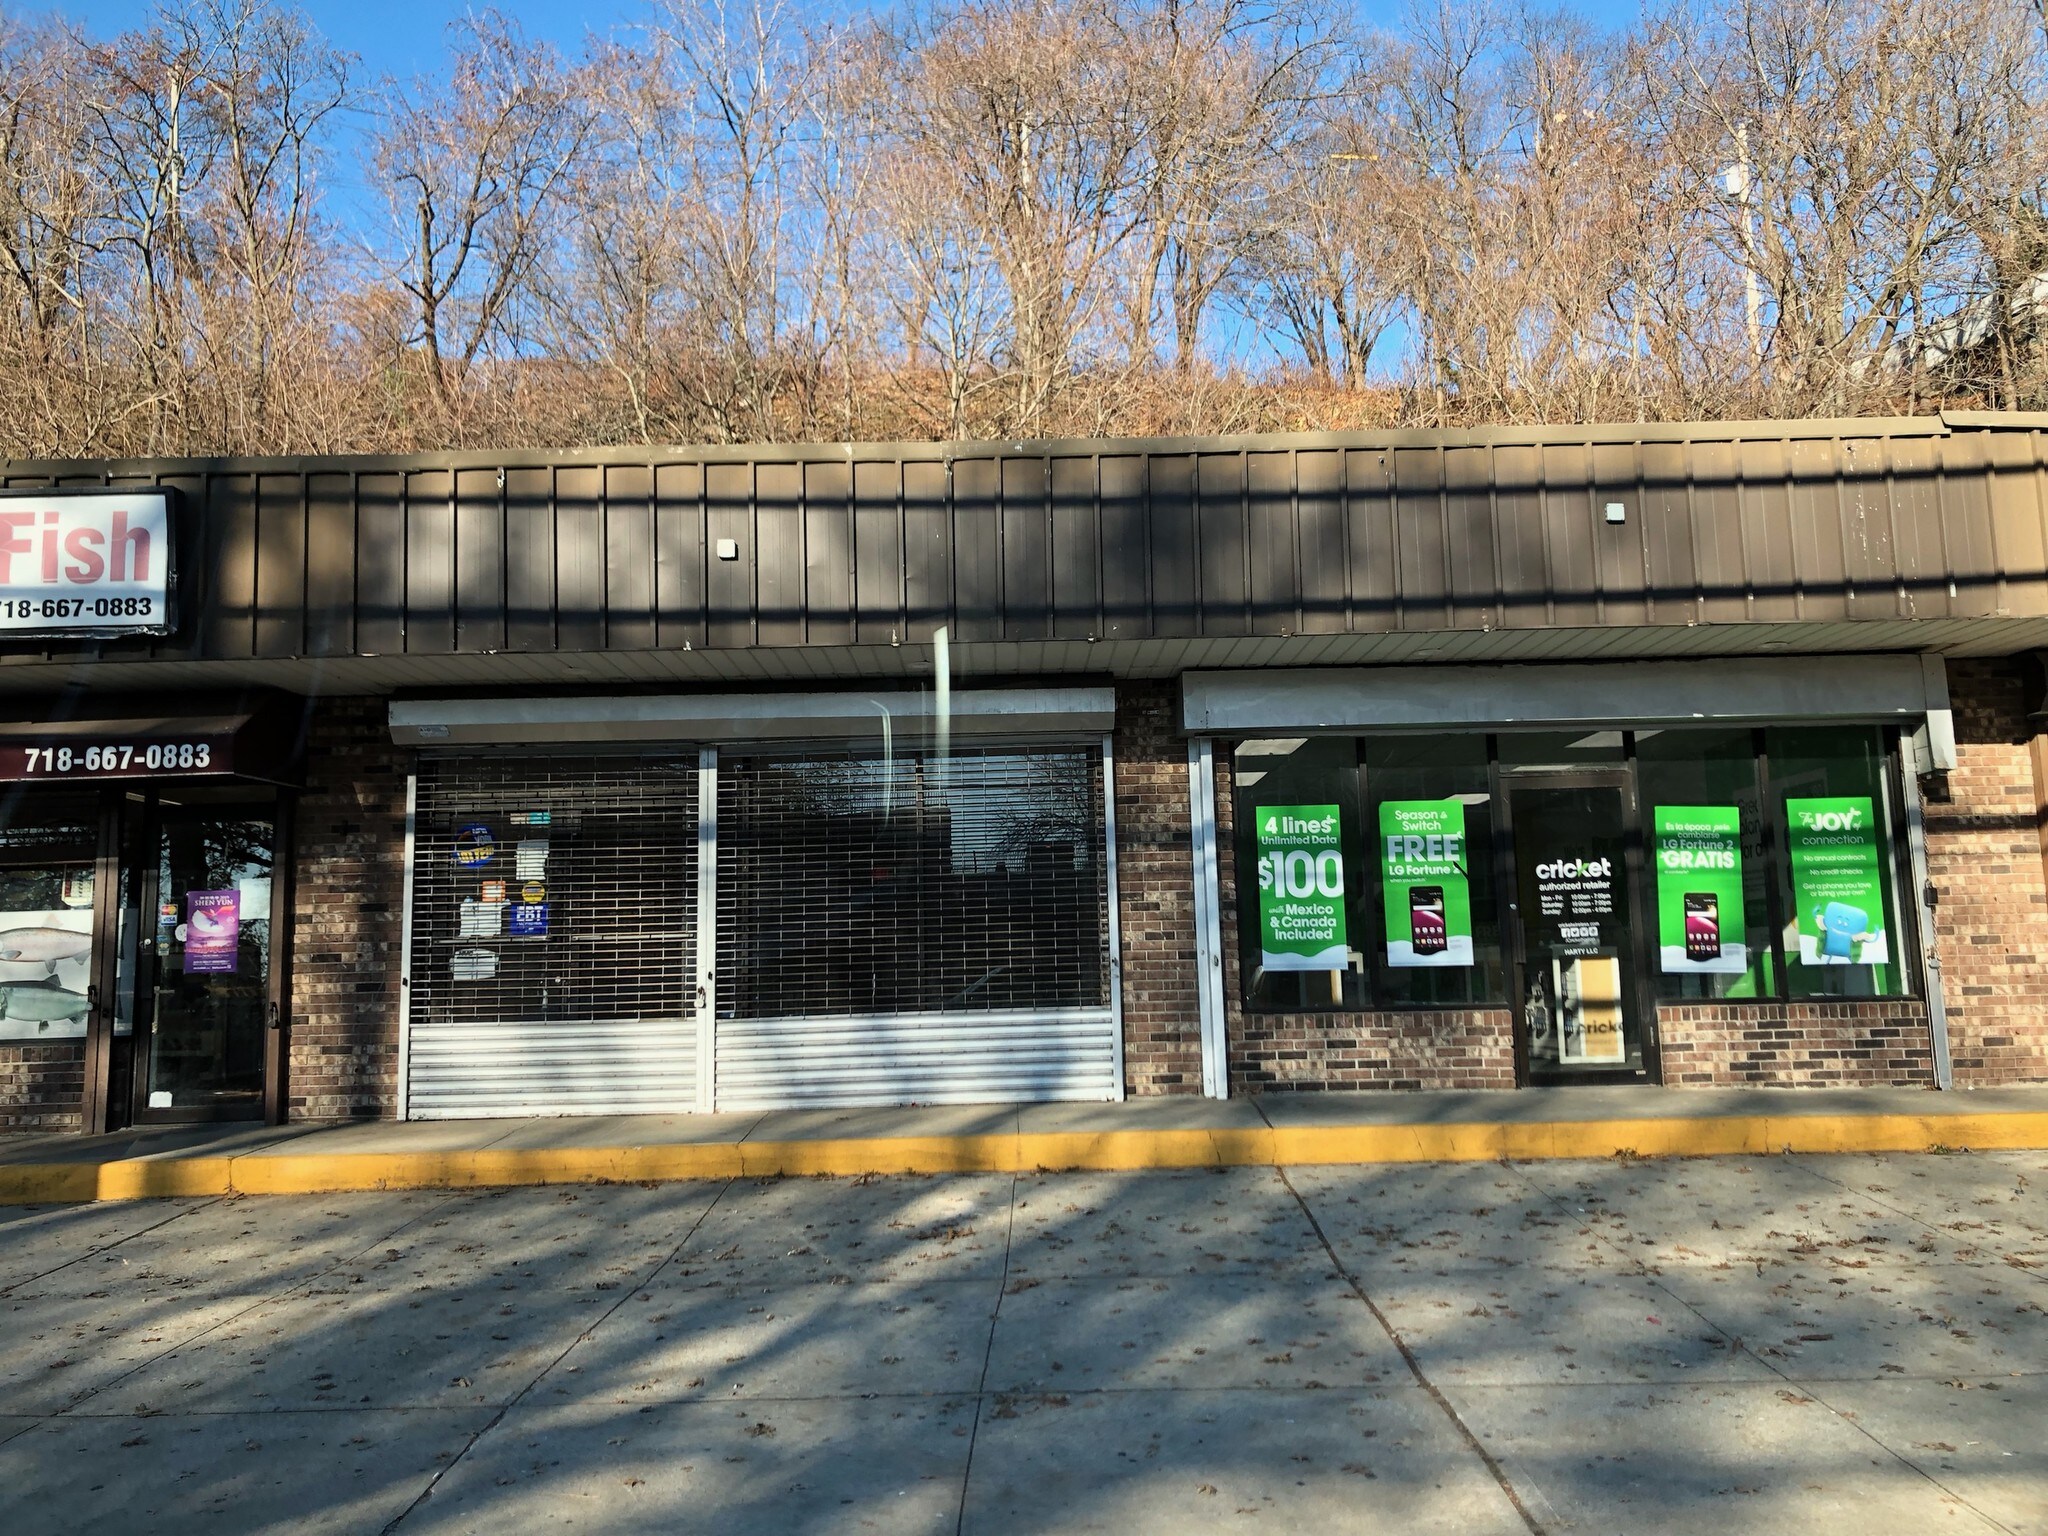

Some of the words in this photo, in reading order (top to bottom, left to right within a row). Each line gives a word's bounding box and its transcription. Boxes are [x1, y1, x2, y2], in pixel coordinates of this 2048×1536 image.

[0, 511, 150, 584] Fish
[0, 597, 152, 619] 18-667-0883
[25, 743, 210, 772] 718-667-0883
[1395, 810, 1439, 820] Season
[1811, 811, 1854, 831] JOY
[1265, 816, 1278, 834] 4
[1282, 816, 1332, 834] lines
[1402, 820, 1442, 831] Switch
[1261, 835, 1310, 845] Unlimited
[1311, 835, 1337, 844] Data
[1677, 831, 1720, 840] cambiarse
[1802, 835, 1865, 845] connection
[1386, 833, 1461, 863] FREE
[1663, 840, 1678, 850] LG
[1680, 840, 1724, 850] Fortune
[1727, 840, 1734, 850] 2
[1663, 850, 1735, 869] GRATIS
[1258, 849, 1344, 898] $100
[1388, 865, 1405, 876] LG
[1406, 864, 1451, 875] Fortune
[1535, 857, 1612, 880] cricket
[1538, 882, 1581, 892] authorized
[1582, 880, 1611, 890] retailer
[1802, 882, 1816, 890] Get
[1822, 883, 1844, 891] phone
[1817, 890, 1836, 898] bring
[516, 905, 544, 922] EBT
[1285, 903, 1334, 915] Mexico
[1270, 916, 1280, 928] &
[1281, 915, 1337, 928] Canada
[1275, 928, 1333, 940] Included
